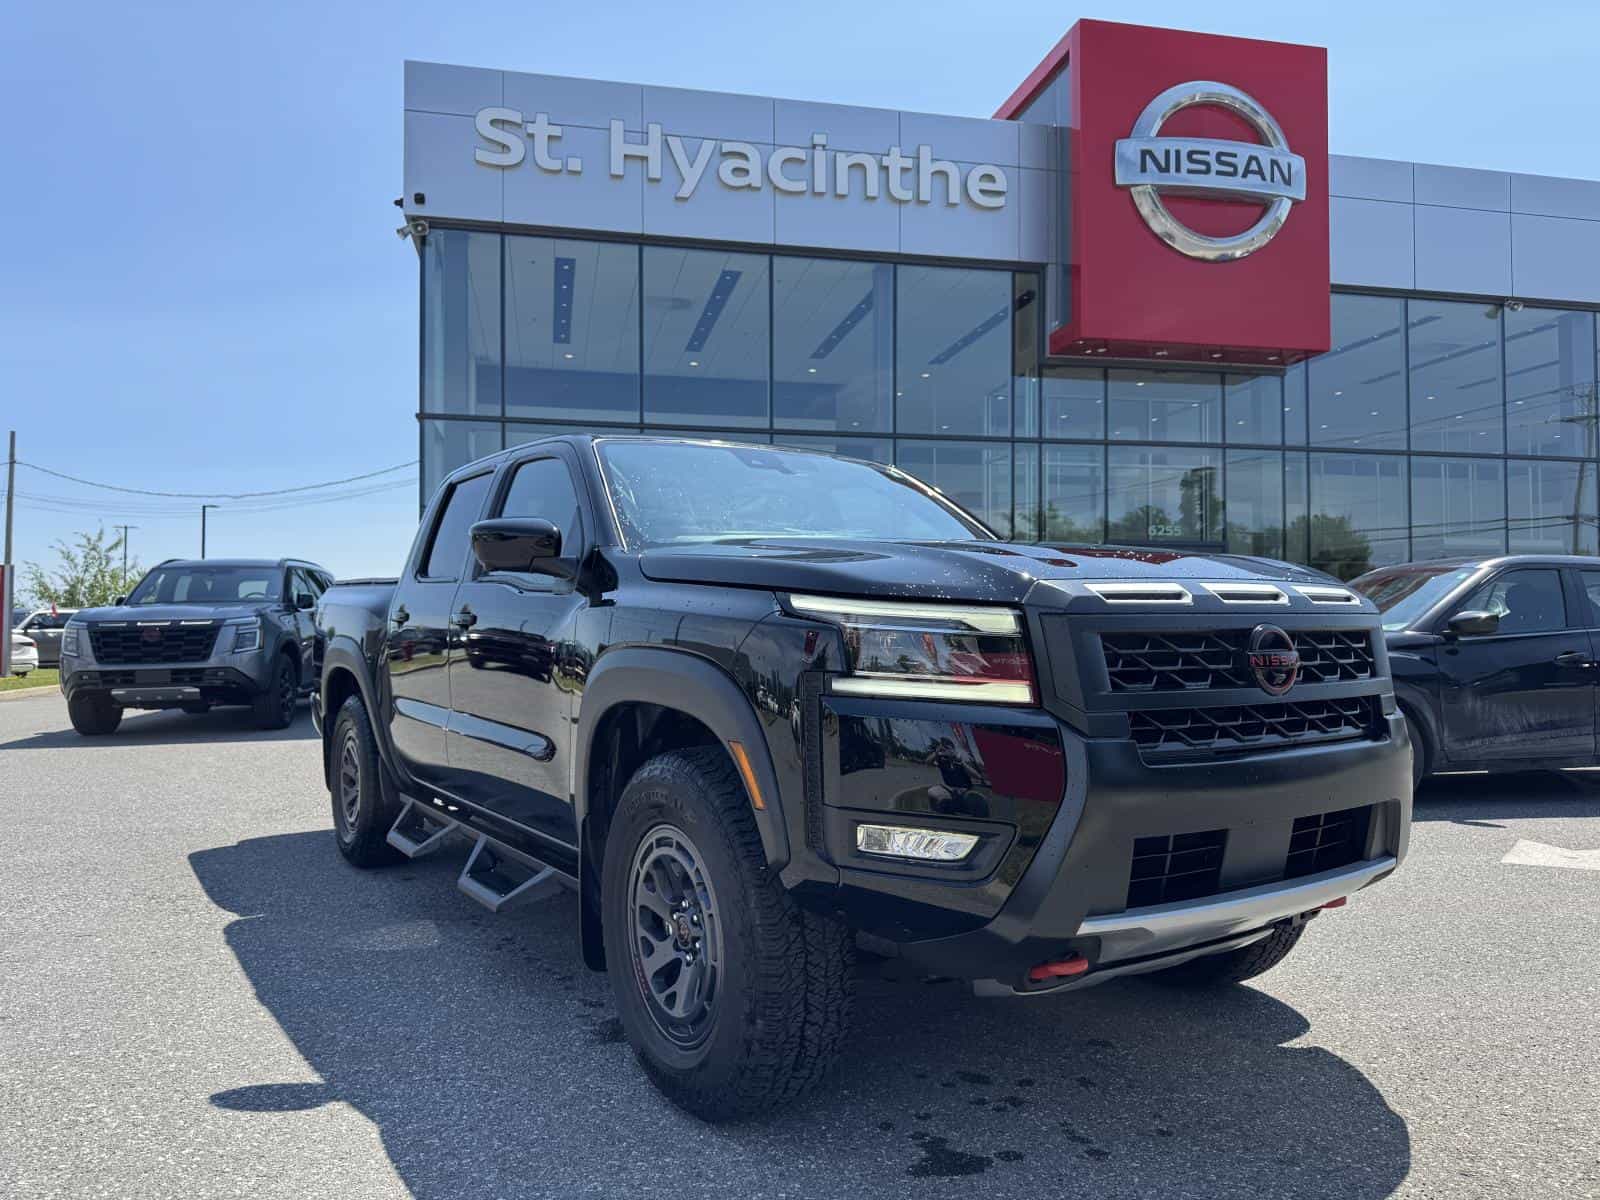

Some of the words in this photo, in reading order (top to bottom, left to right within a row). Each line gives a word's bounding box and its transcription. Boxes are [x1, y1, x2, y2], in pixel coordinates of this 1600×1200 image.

[474, 106, 583, 173] St.
[609, 119, 1008, 208] Hyacinthe
[1140, 148, 1293, 187] NISSAN
[1148, 524, 1183, 537] 6255
